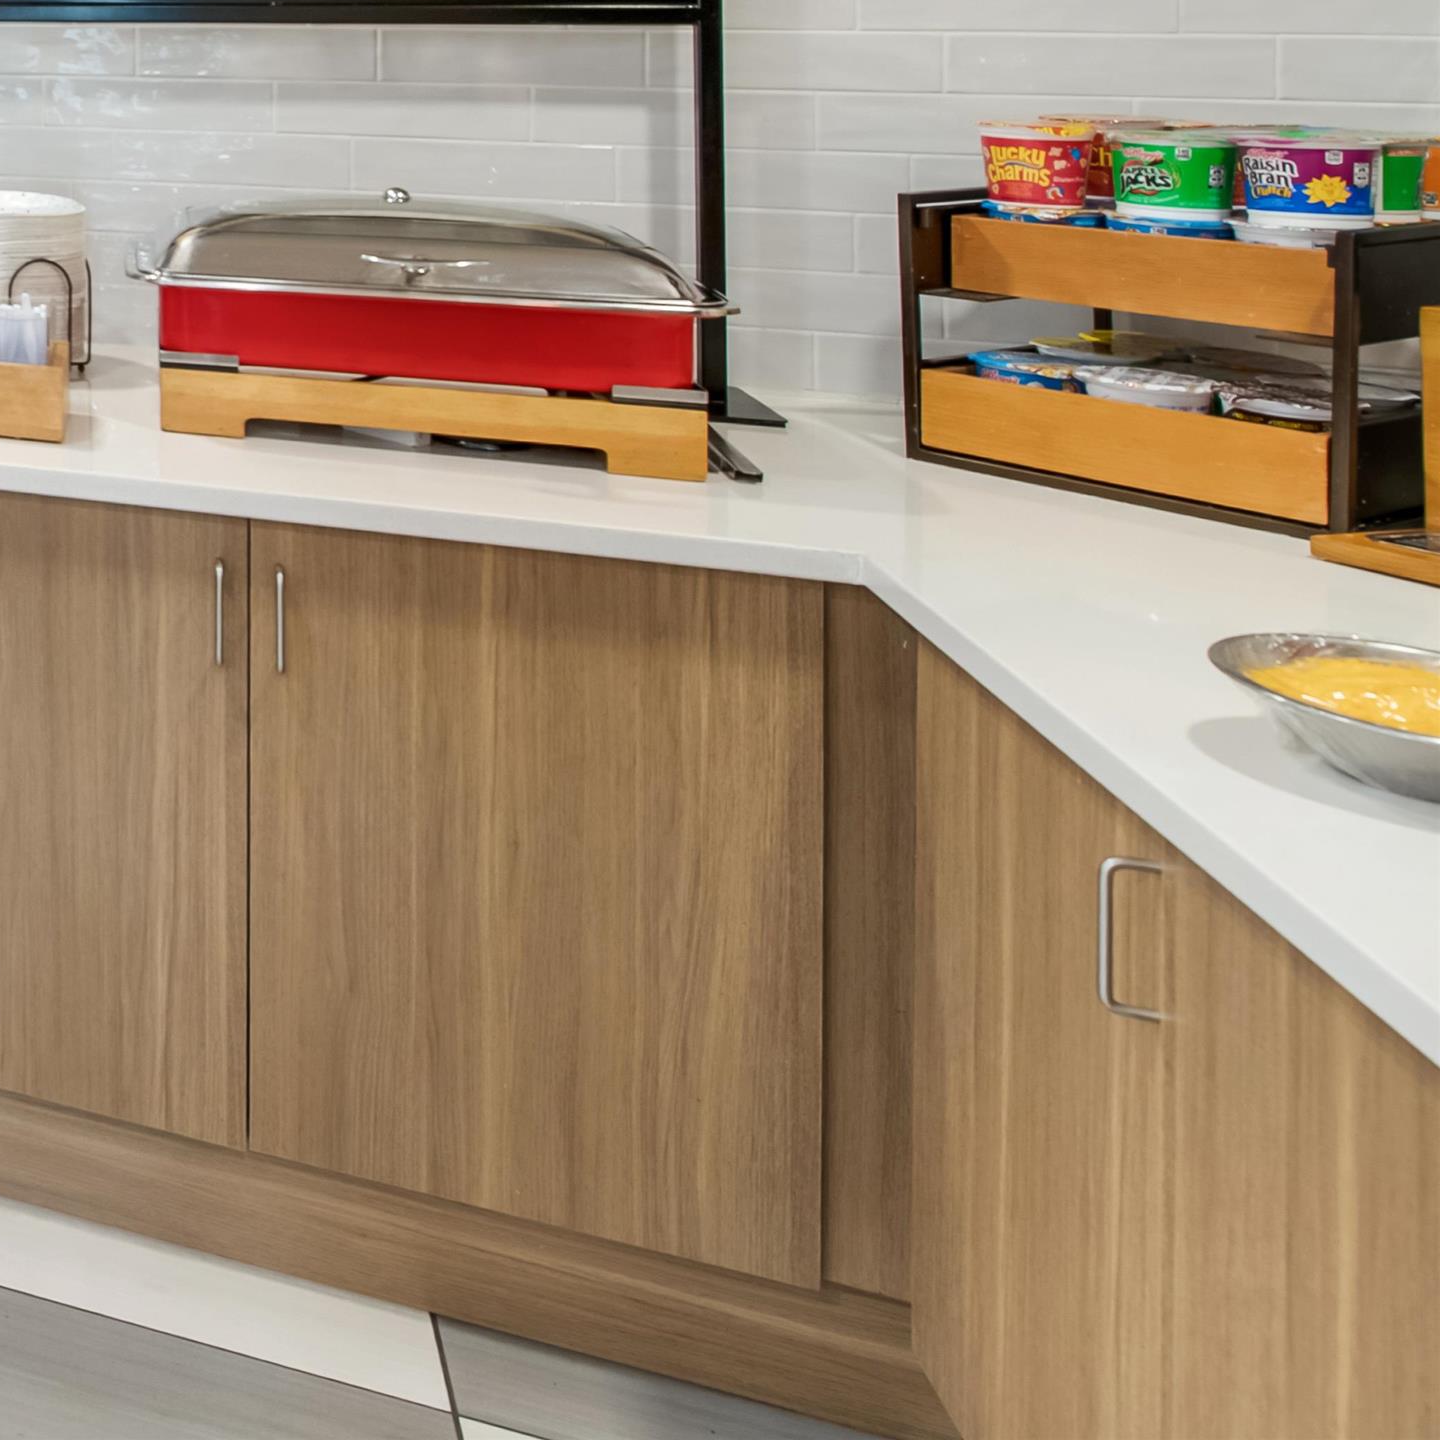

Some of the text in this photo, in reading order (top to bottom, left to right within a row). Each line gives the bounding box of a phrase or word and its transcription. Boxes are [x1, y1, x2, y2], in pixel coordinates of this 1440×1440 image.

[989, 144, 1046, 168] Lucky
[987, 162, 1052, 188] Charms
[1125, 165, 1157, 176] APPLE
[1243, 157, 1296, 177] Raisin
[1120, 172, 1172, 195] JACKS
[1250, 171, 1291, 189] Bran
